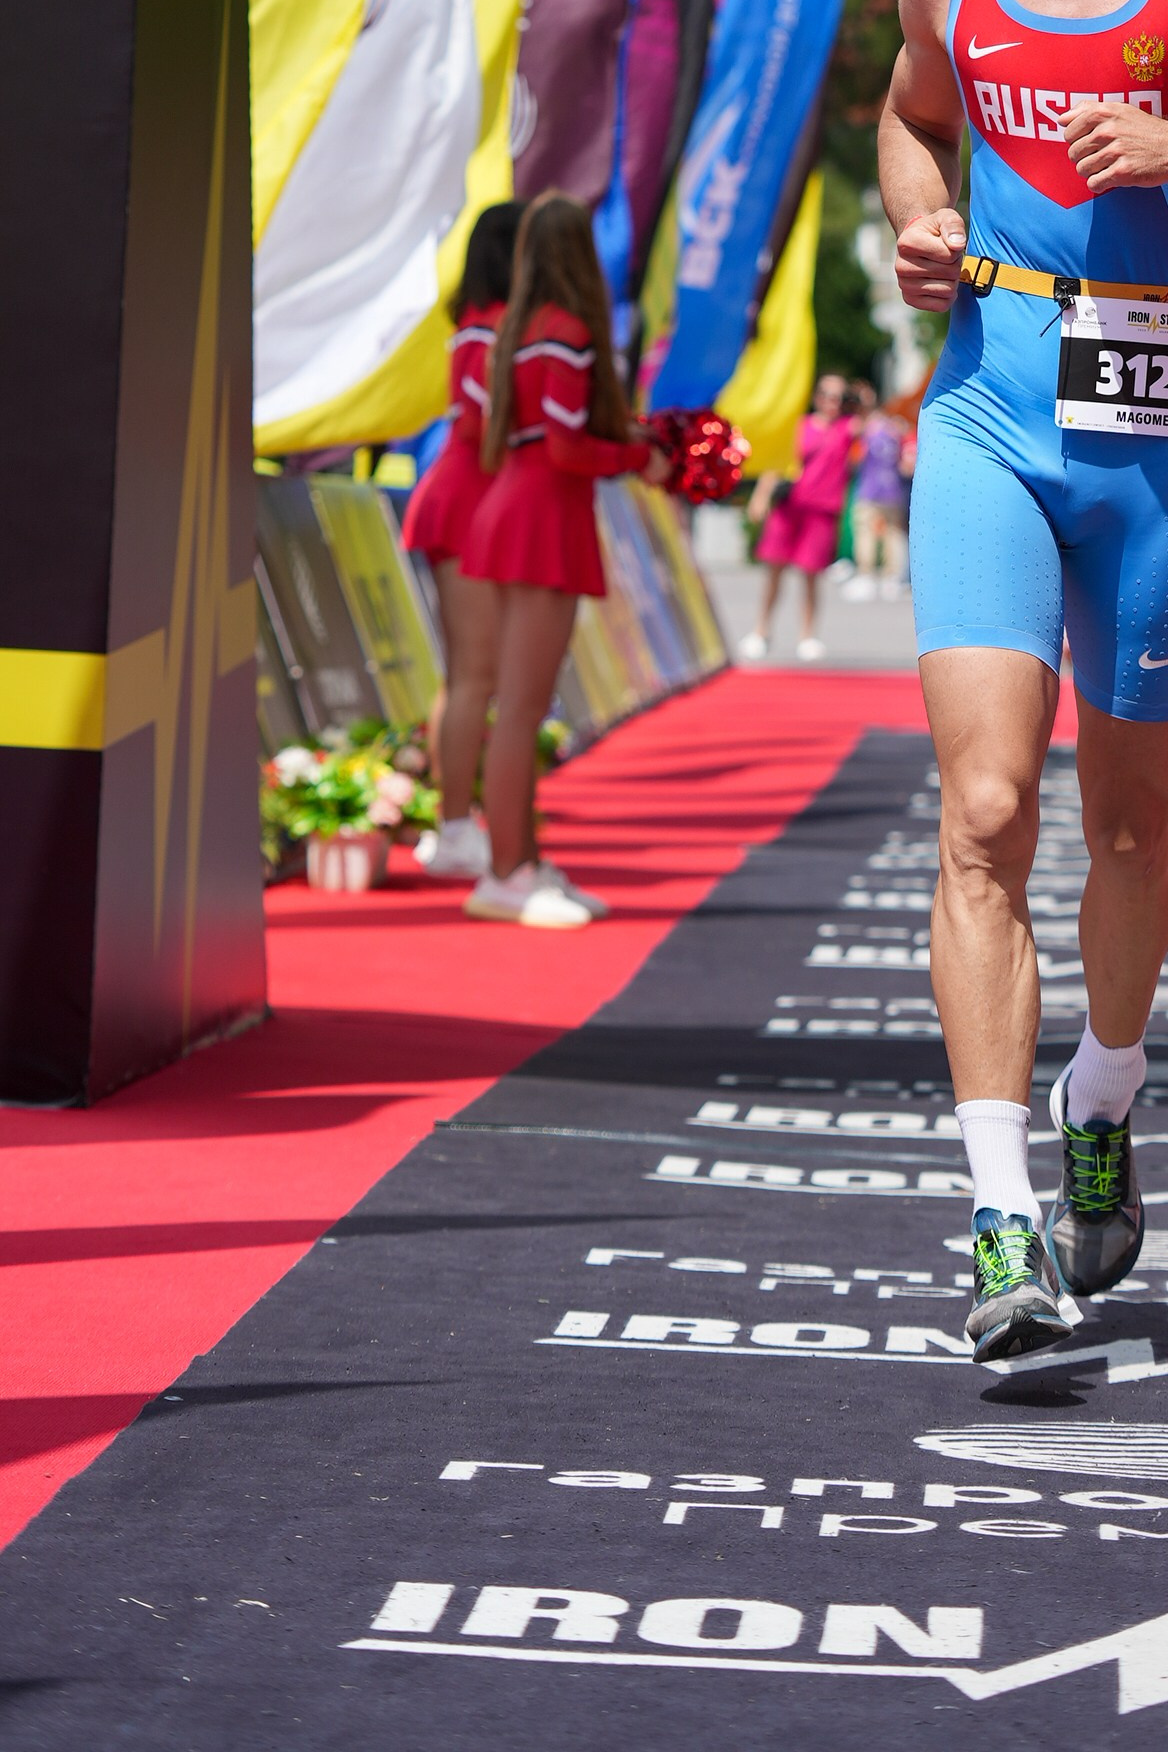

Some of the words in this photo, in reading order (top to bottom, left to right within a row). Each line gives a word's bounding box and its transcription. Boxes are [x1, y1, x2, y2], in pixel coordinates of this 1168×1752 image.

[973, 80, 1163, 143] RUS
[1128, 311, 1149, 323] IRON
[554, 1310, 974, 1355] IRON
[371, 1581, 984, 1659] IRON
